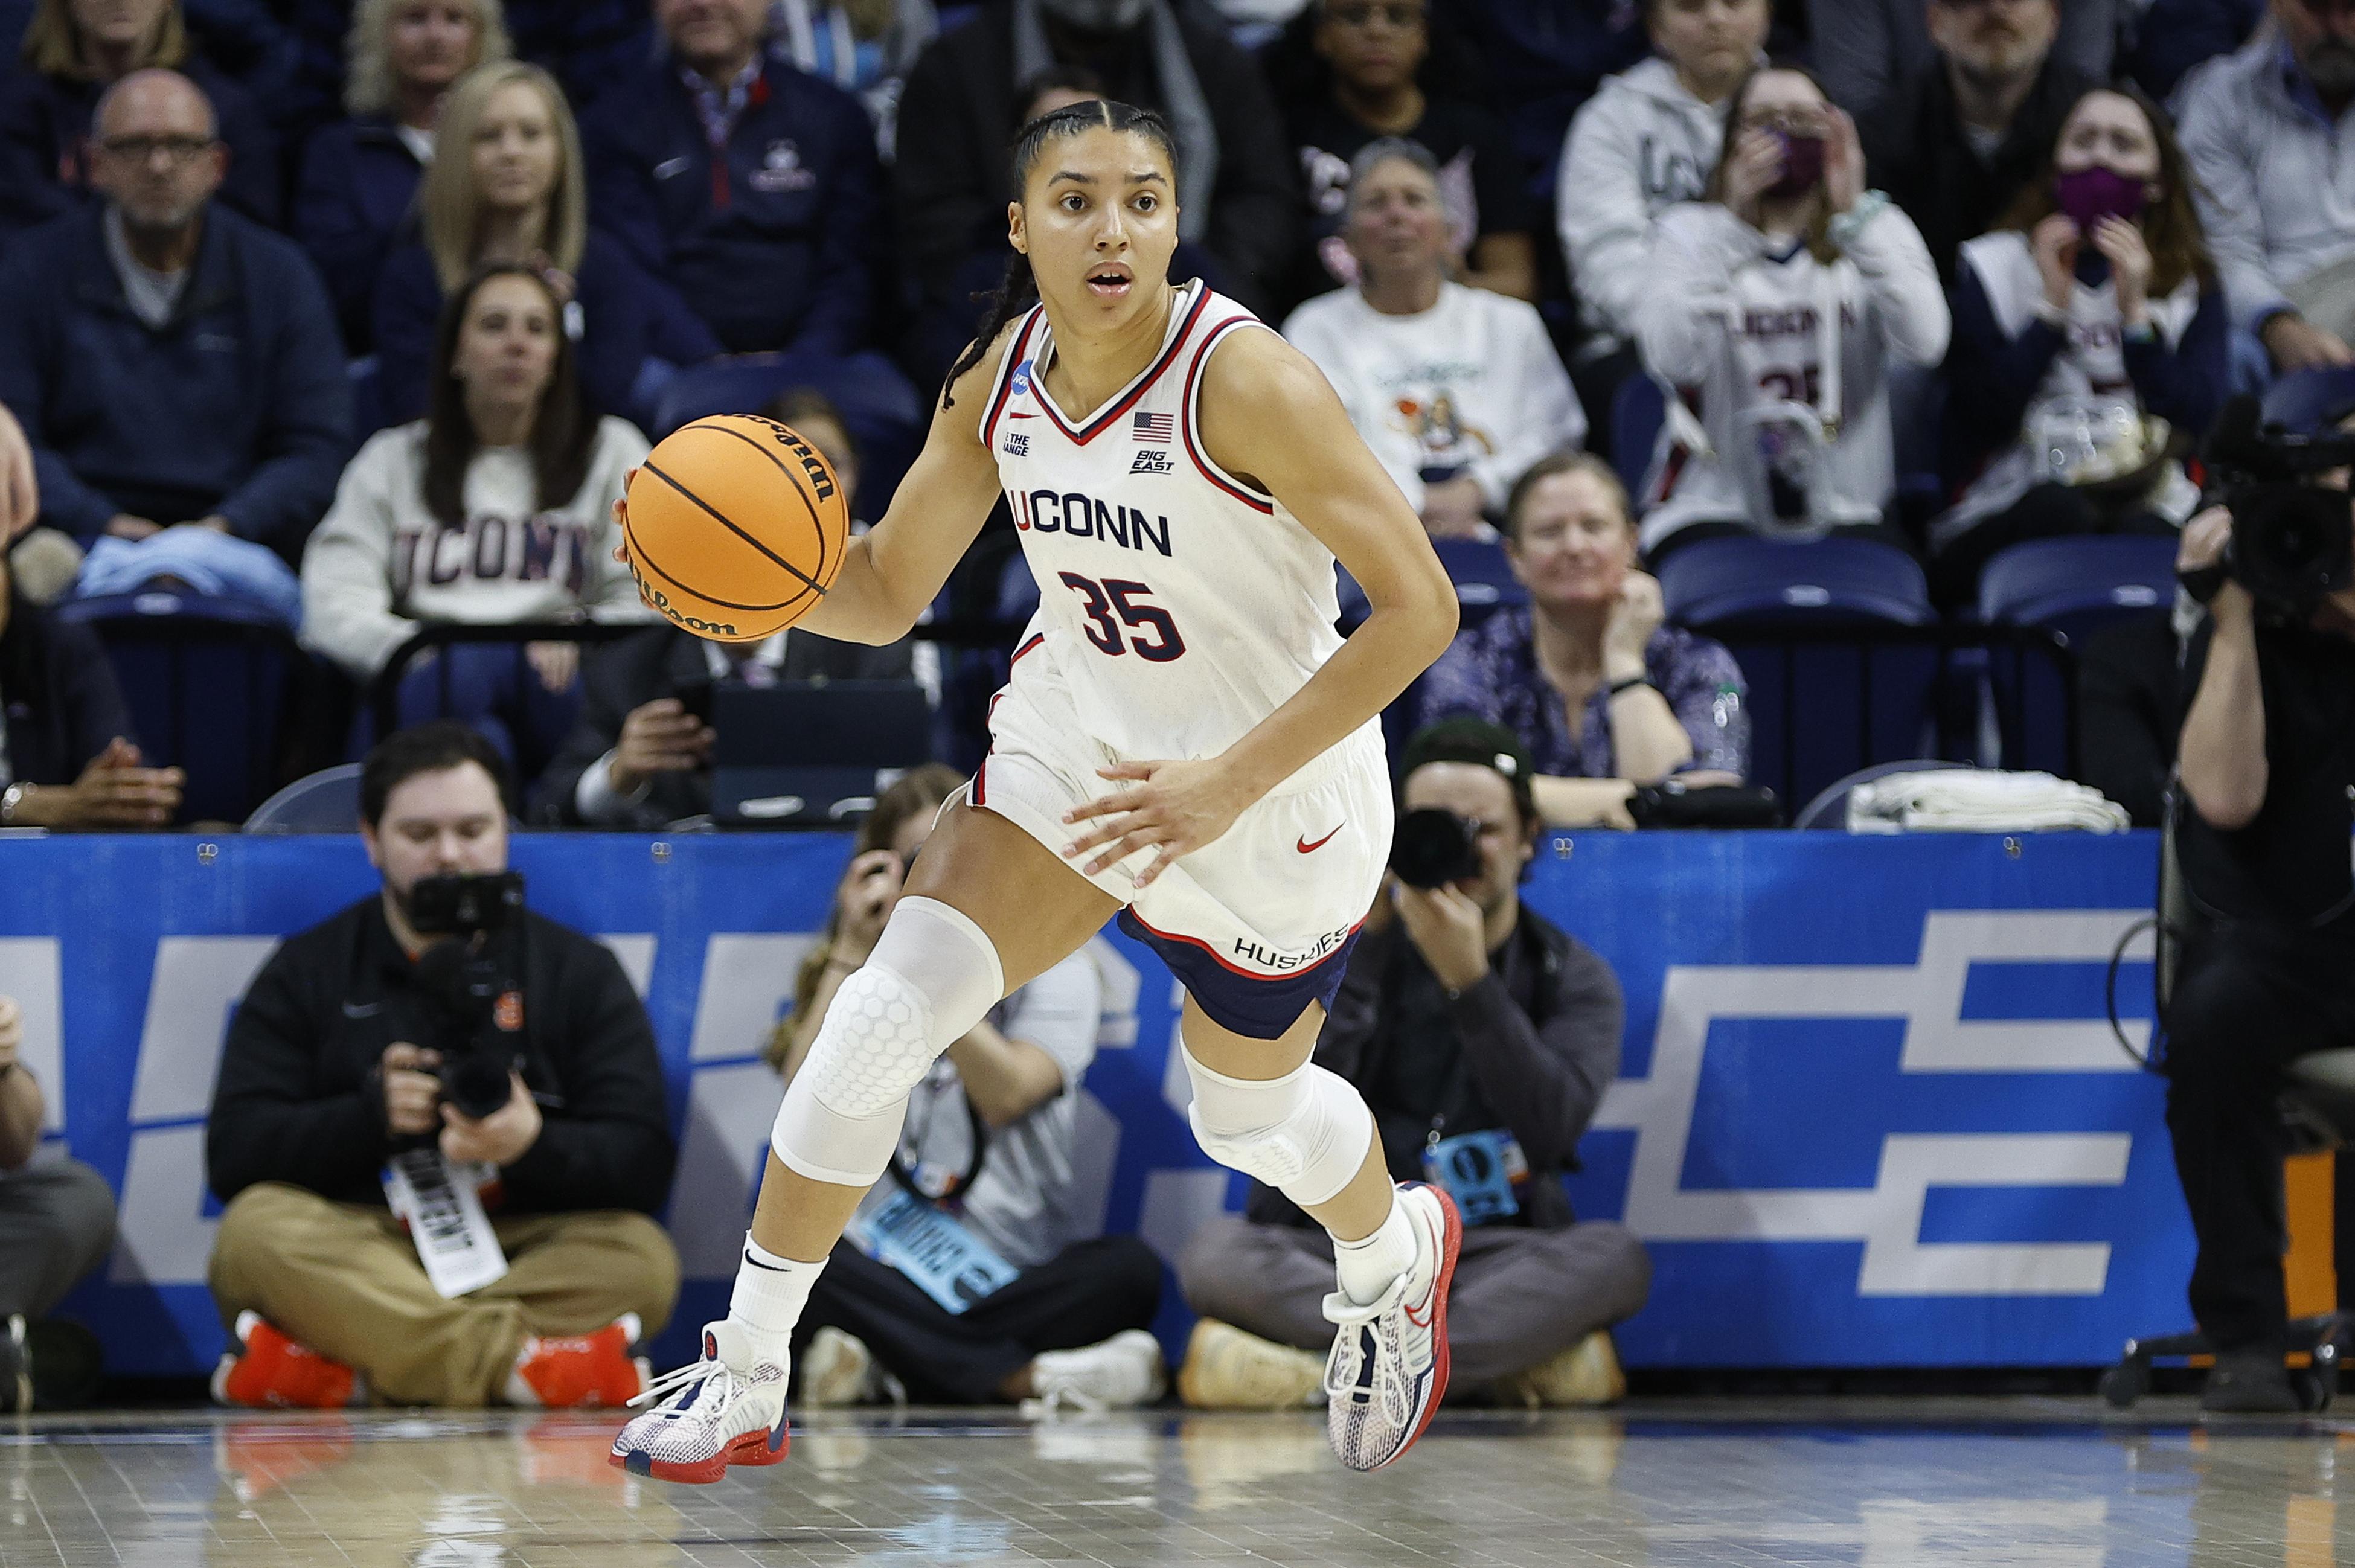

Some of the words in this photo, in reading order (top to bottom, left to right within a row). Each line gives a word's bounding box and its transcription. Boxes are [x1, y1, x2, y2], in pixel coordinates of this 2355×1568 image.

[1010, 433, 1030, 446] THE
[1131, 460, 1175, 471] EAST
[1136, 450, 1167, 461] BIG
[1010, 490, 1172, 557] UCONN
[1057, 571, 1187, 662] 35
[1234, 923, 1348, 969] HUSKIES
